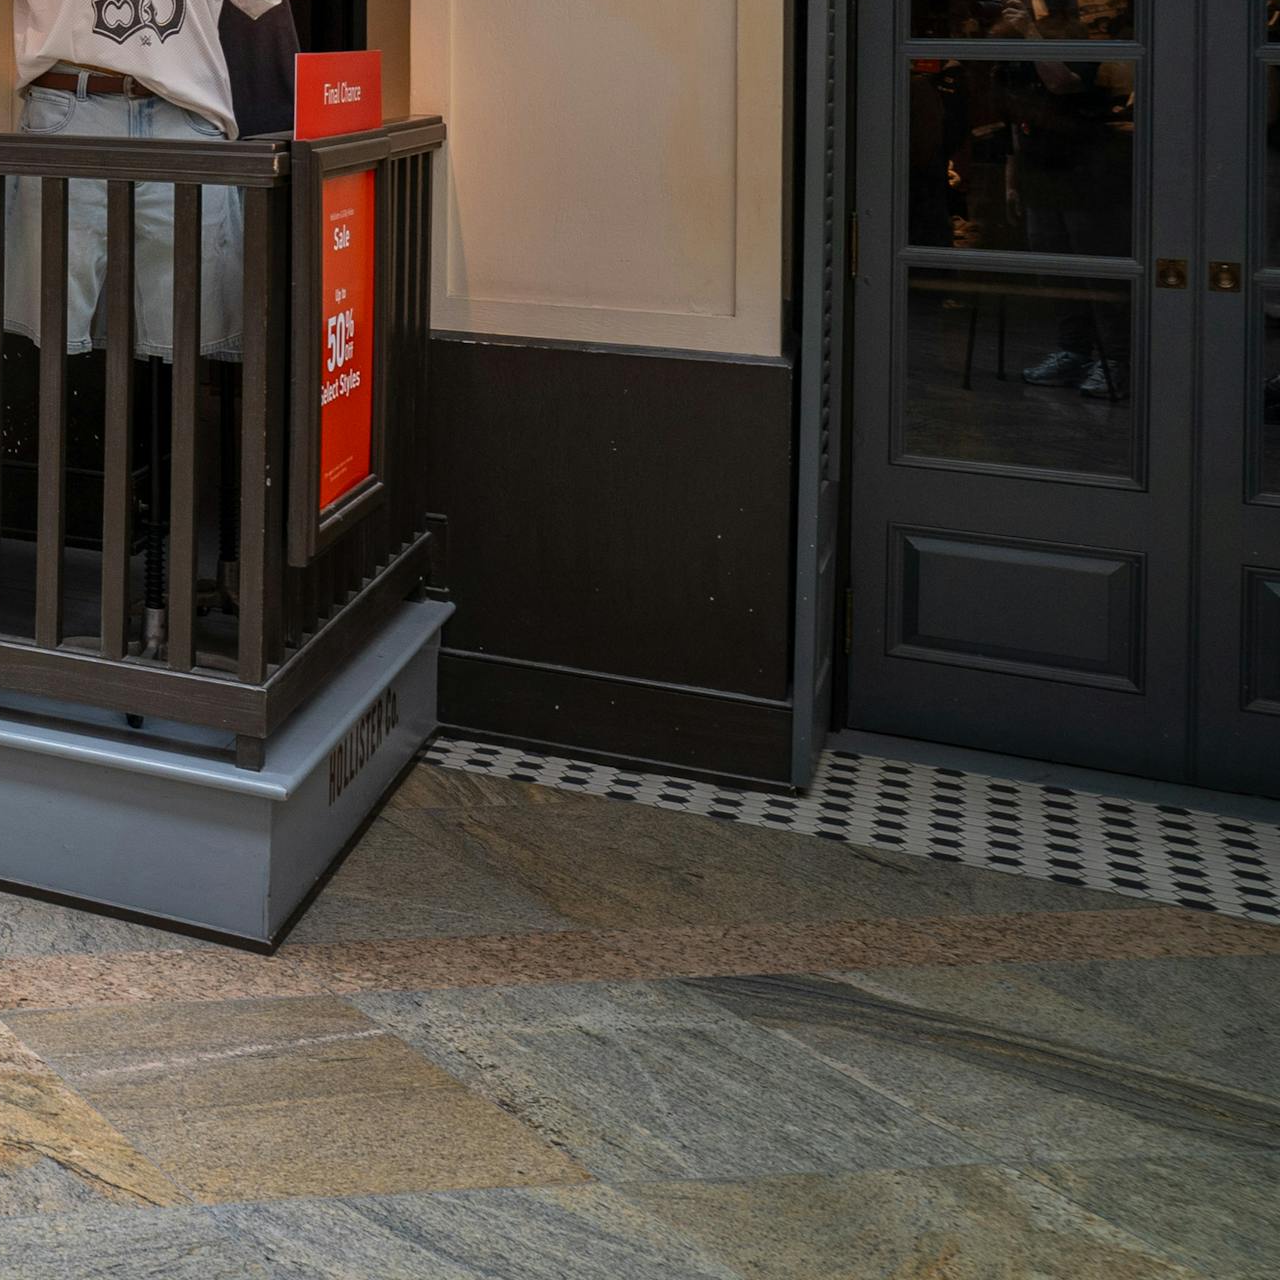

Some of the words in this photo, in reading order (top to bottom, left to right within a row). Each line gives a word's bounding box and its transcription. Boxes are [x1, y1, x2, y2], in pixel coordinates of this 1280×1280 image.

[324, 82, 340, 105] Final
[341, 81, 361, 103] Chance
[333, 224, 350, 251] Sale
[327, 308, 354, 372] 50%
[328, 699, 383, 806] HOLLISTER
